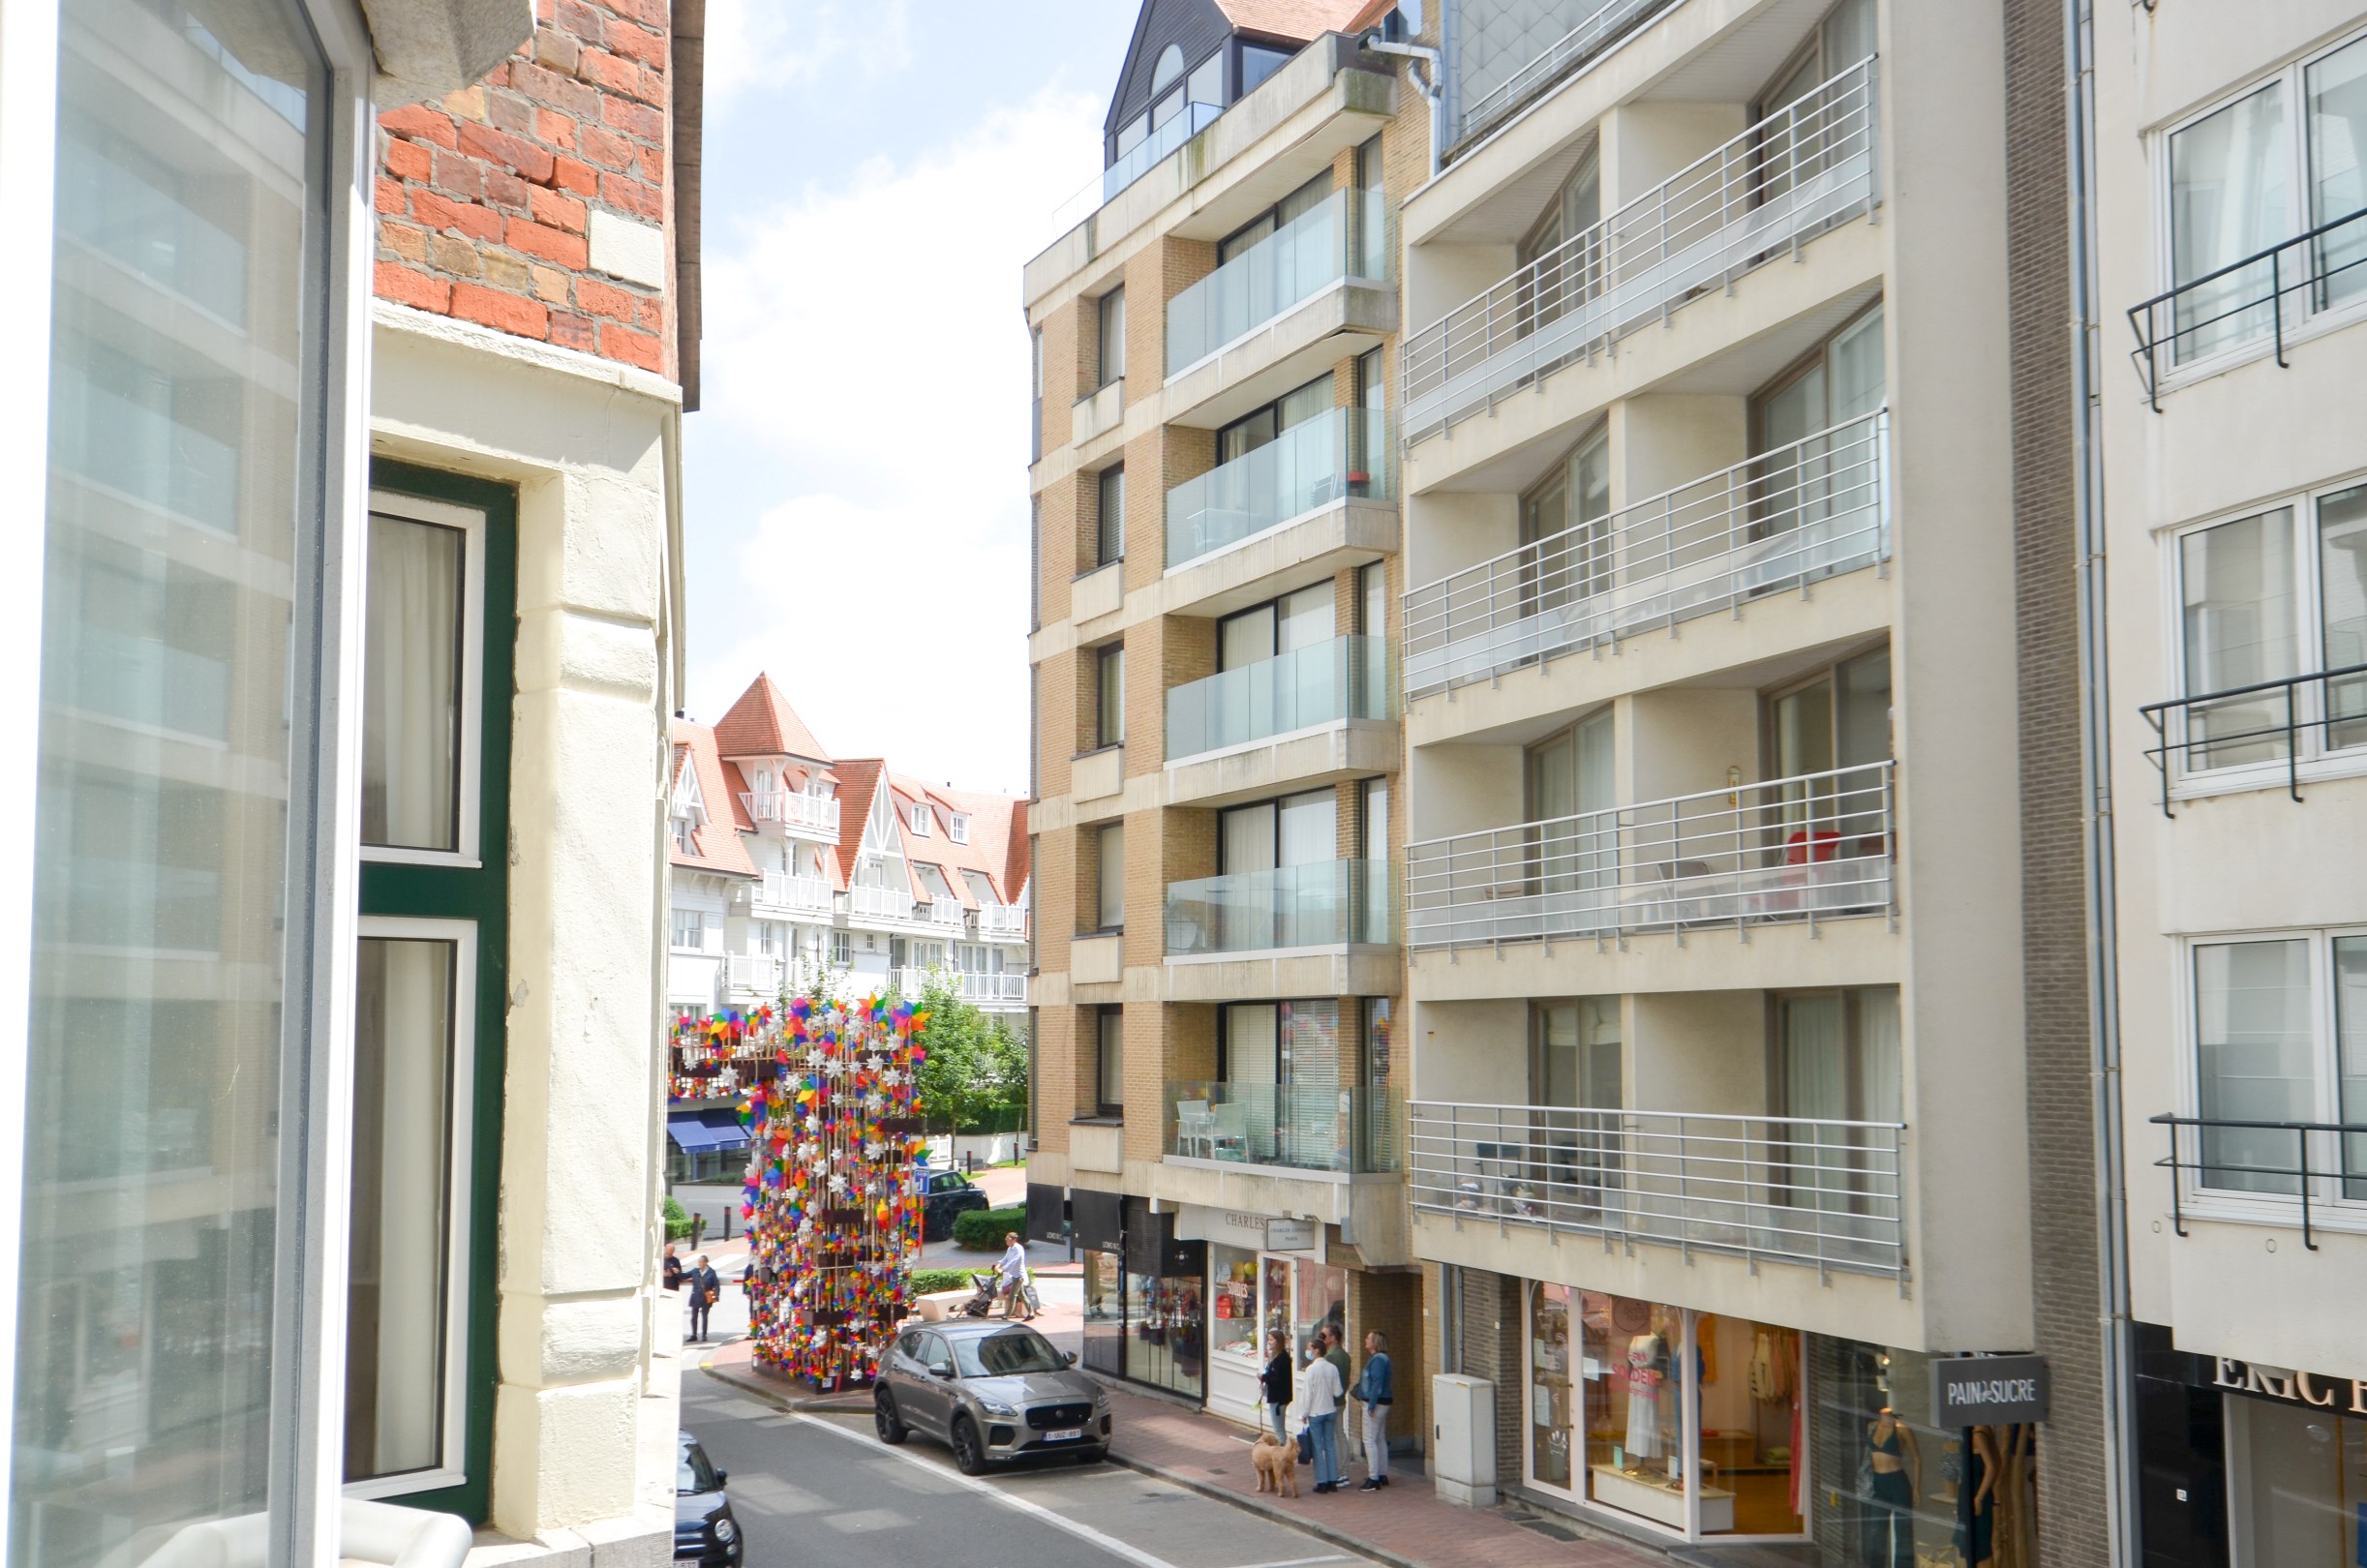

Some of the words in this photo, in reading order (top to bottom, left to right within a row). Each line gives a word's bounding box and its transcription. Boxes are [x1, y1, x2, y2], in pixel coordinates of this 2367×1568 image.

[1225, 1212, 1264, 1230] CHARLES
[1948, 1382, 1982, 1405] PAIN
[1990, 1379, 2036, 1403] SUCRE
